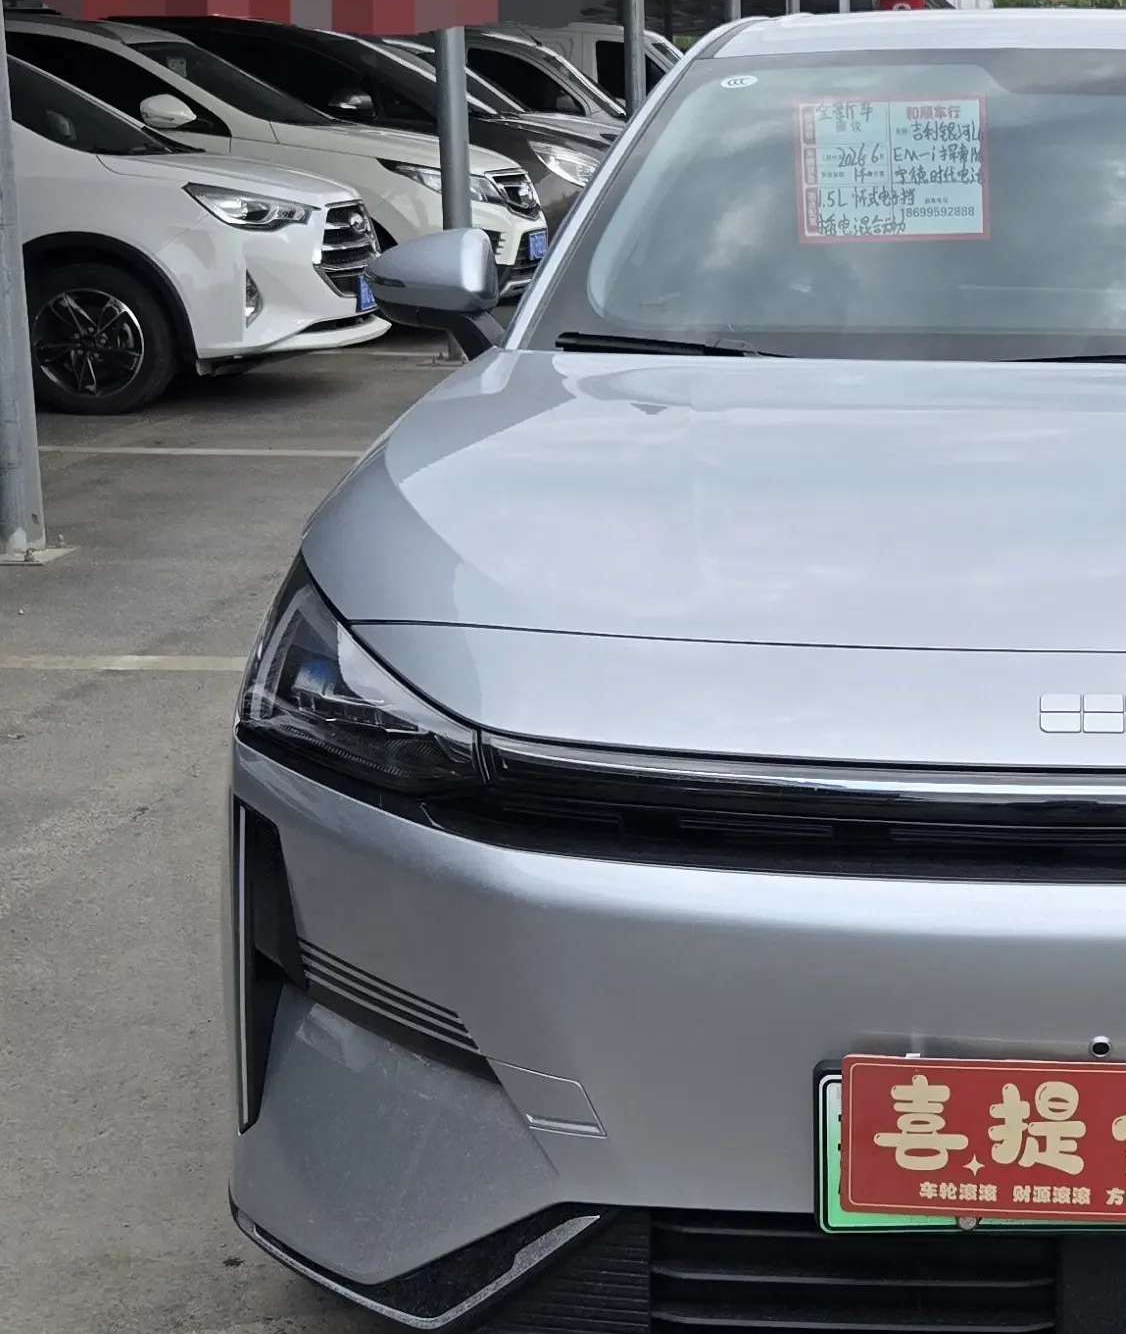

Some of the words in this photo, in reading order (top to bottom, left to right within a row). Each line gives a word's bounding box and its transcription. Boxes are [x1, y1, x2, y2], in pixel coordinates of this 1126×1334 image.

[919, 1181, 998, 1202] 车轮滚滚
[1012, 1185, 1091, 1205] 财源滚滚
